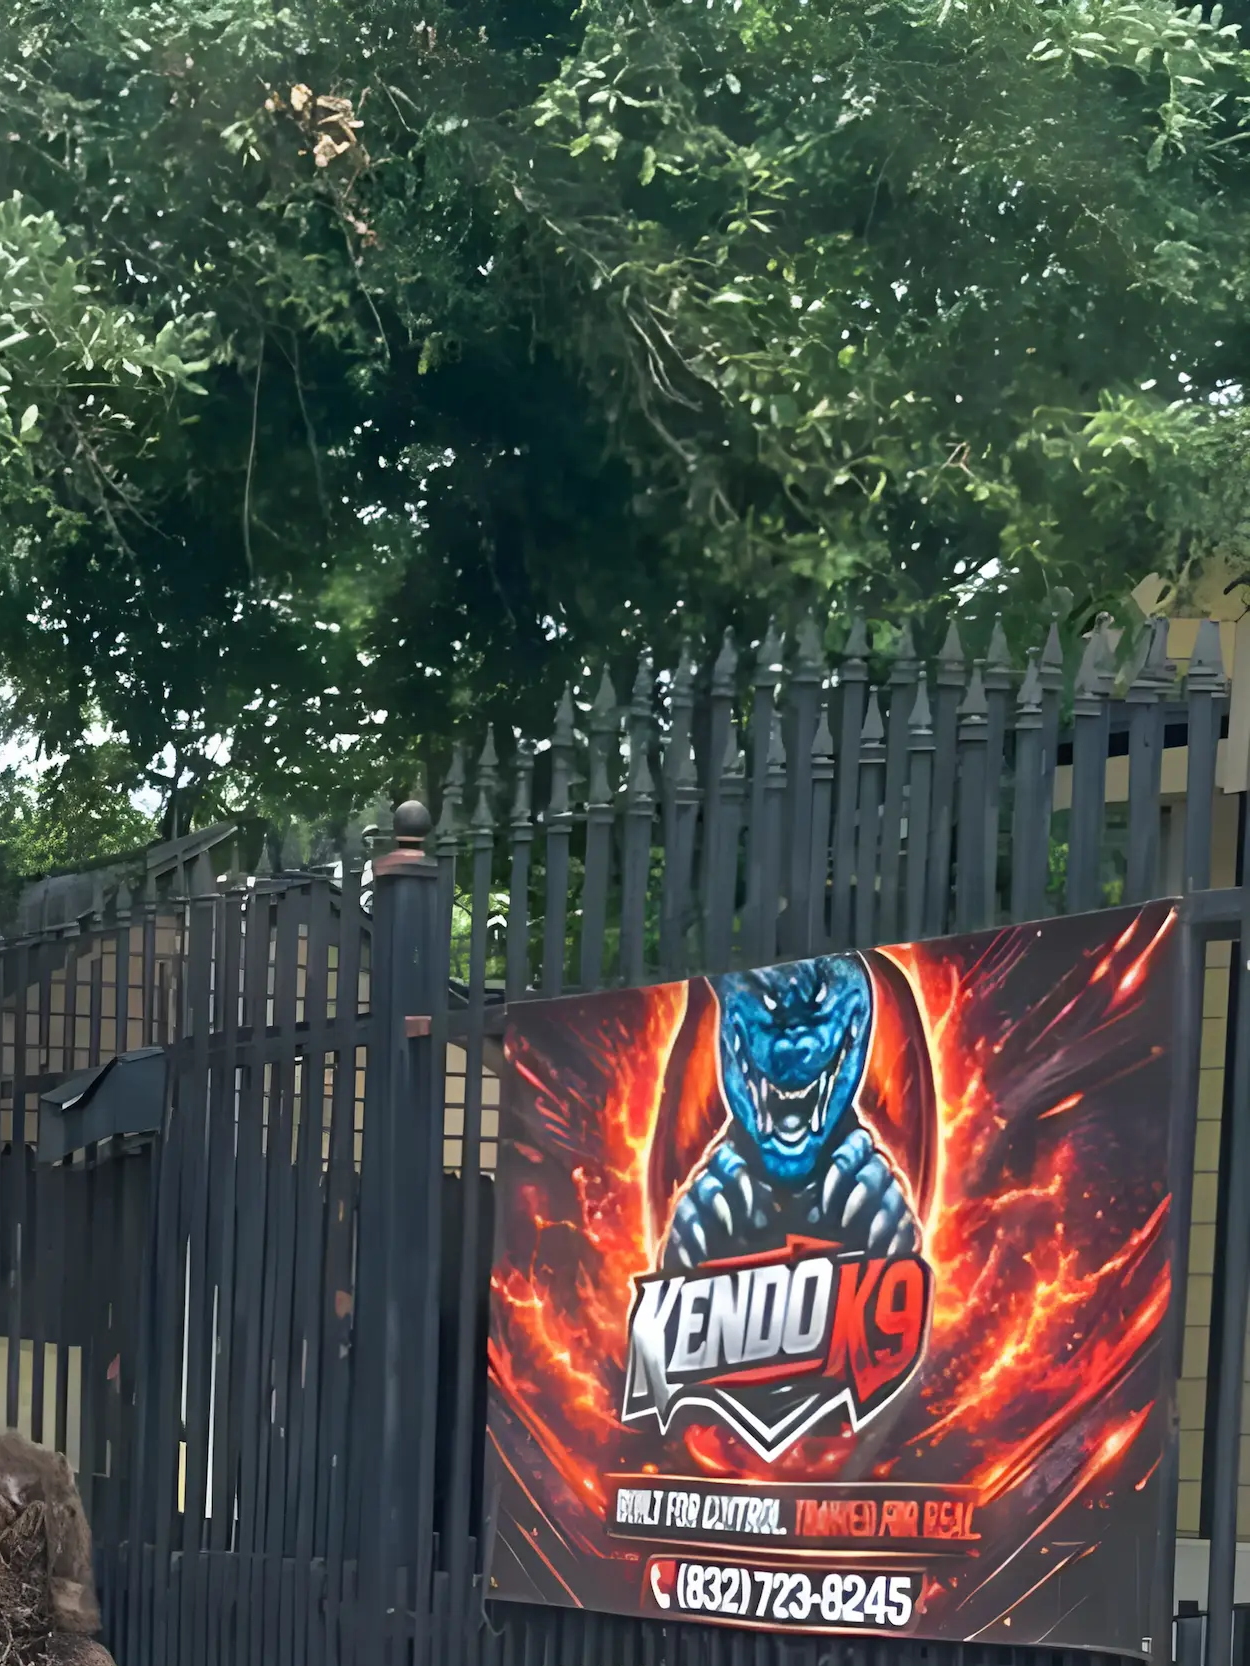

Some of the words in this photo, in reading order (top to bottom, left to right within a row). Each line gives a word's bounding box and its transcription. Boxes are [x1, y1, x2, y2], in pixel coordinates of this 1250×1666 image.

[631, 1257, 833, 1399] KENDO
[822, 1258, 924, 1403] K9
[666, 1491, 701, 1528] FOR
[676, 1562, 751, 1615] (832)
[753, 1571, 912, 1626] 723-8245
